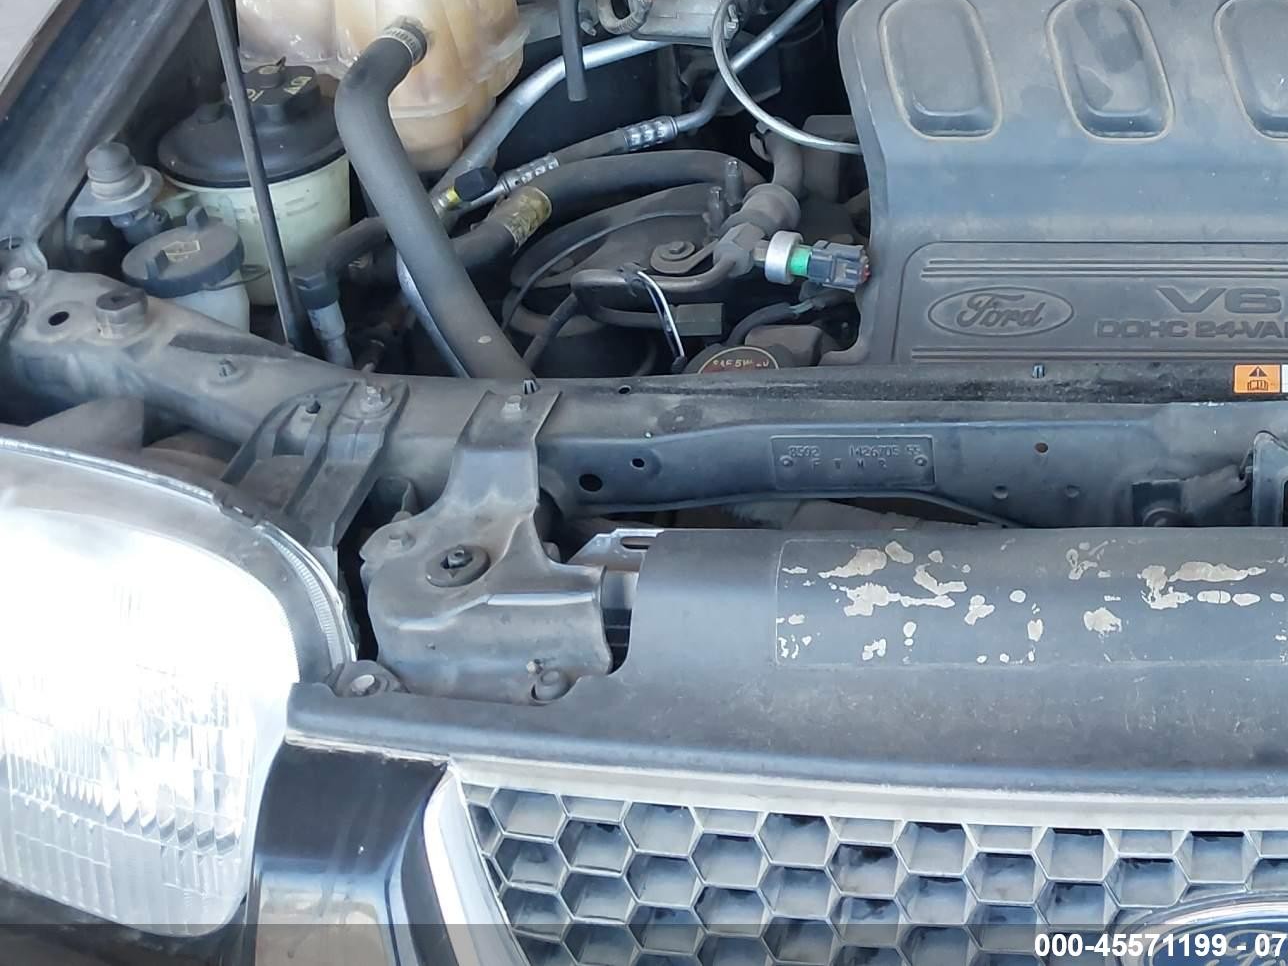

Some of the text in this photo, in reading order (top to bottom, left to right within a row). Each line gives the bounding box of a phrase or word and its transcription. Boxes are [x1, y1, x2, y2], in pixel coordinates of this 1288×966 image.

[956, 293, 1046, 327] Ford
[1156, 287, 1282, 314] V6
[1096, 320, 1189, 338] DOHC
